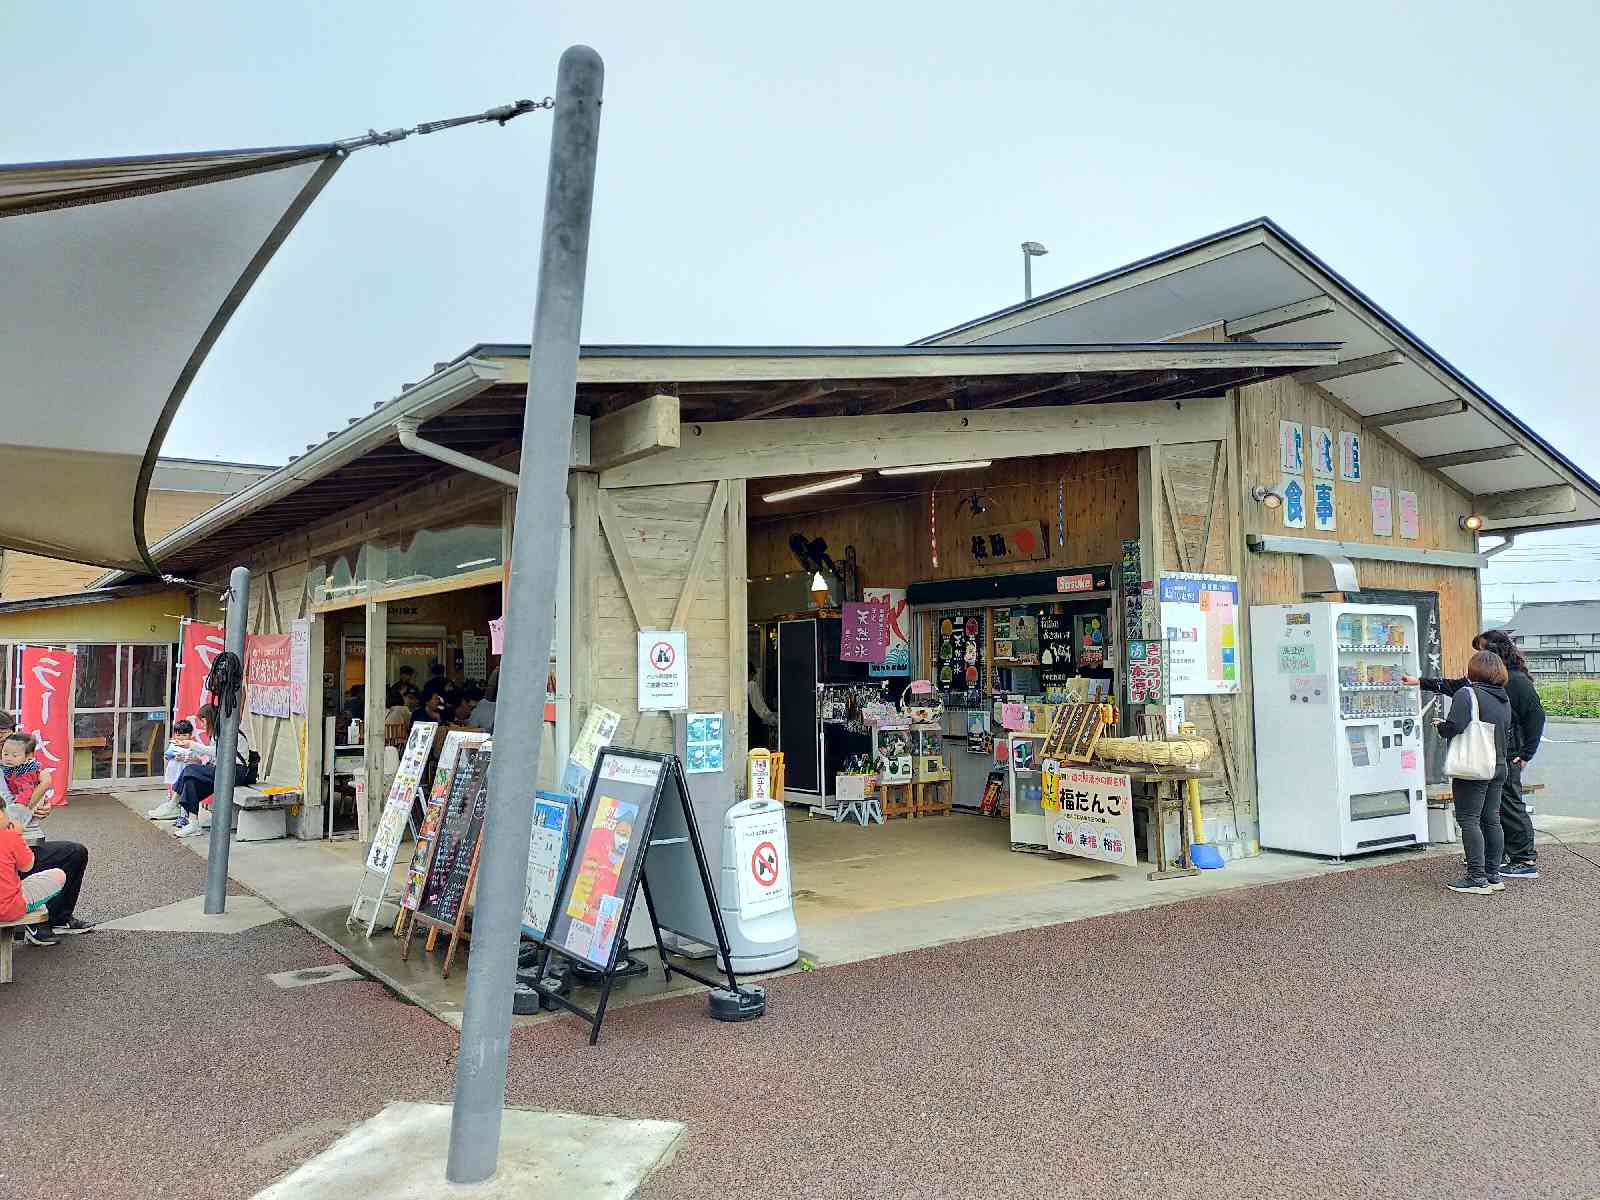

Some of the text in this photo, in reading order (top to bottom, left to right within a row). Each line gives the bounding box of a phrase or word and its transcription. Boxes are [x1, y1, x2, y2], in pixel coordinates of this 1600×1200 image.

[1284, 480, 1334, 525] 食事
[855, 608, 871, 657] 天然氷
[1129, 658, 1147, 702] 一本漬け
[1145, 642, 1161, 700] きゅうりの
[1060, 788, 1122, 816] 福だんご
[1057, 829, 1074, 846] 大福
[1080, 833, 1098, 850] 幸福
[1103, 838, 1124, 854] 裕福
